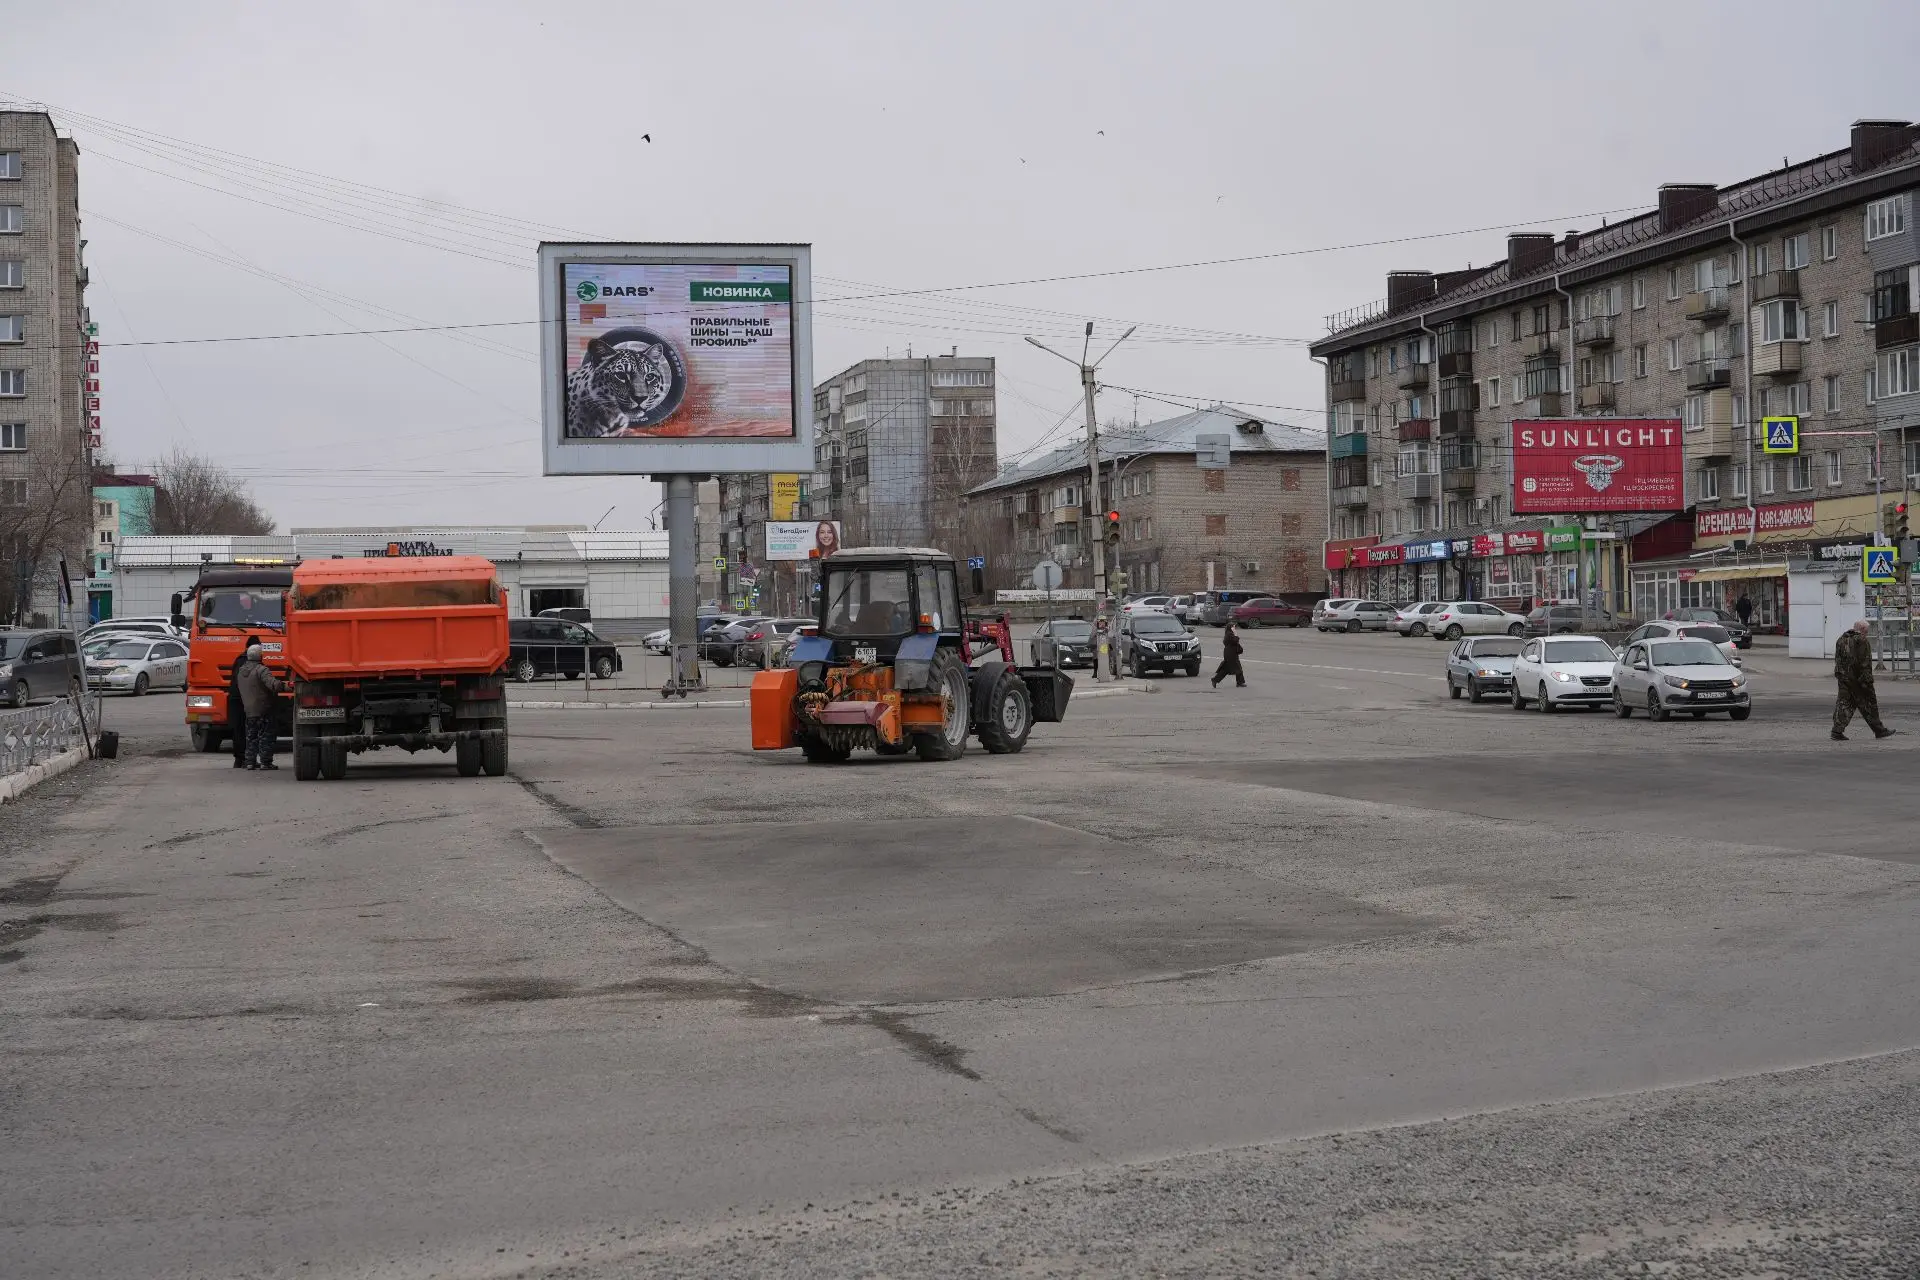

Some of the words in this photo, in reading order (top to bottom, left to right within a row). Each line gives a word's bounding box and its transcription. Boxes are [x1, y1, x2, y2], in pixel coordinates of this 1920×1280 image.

[702, 287, 773, 297] НОВИНКА
[690, 317, 770, 326] ПРАВИЛЬНЫЕ
[690, 328, 729, 336] ШИНЫ
[745, 328, 773, 336] НАШ
[86, 342, 100, 448] АПТЕКА
[1521, 428, 1674, 447] SUNLIGHT
[1700, 512, 1737, 534] АРЕНДА
